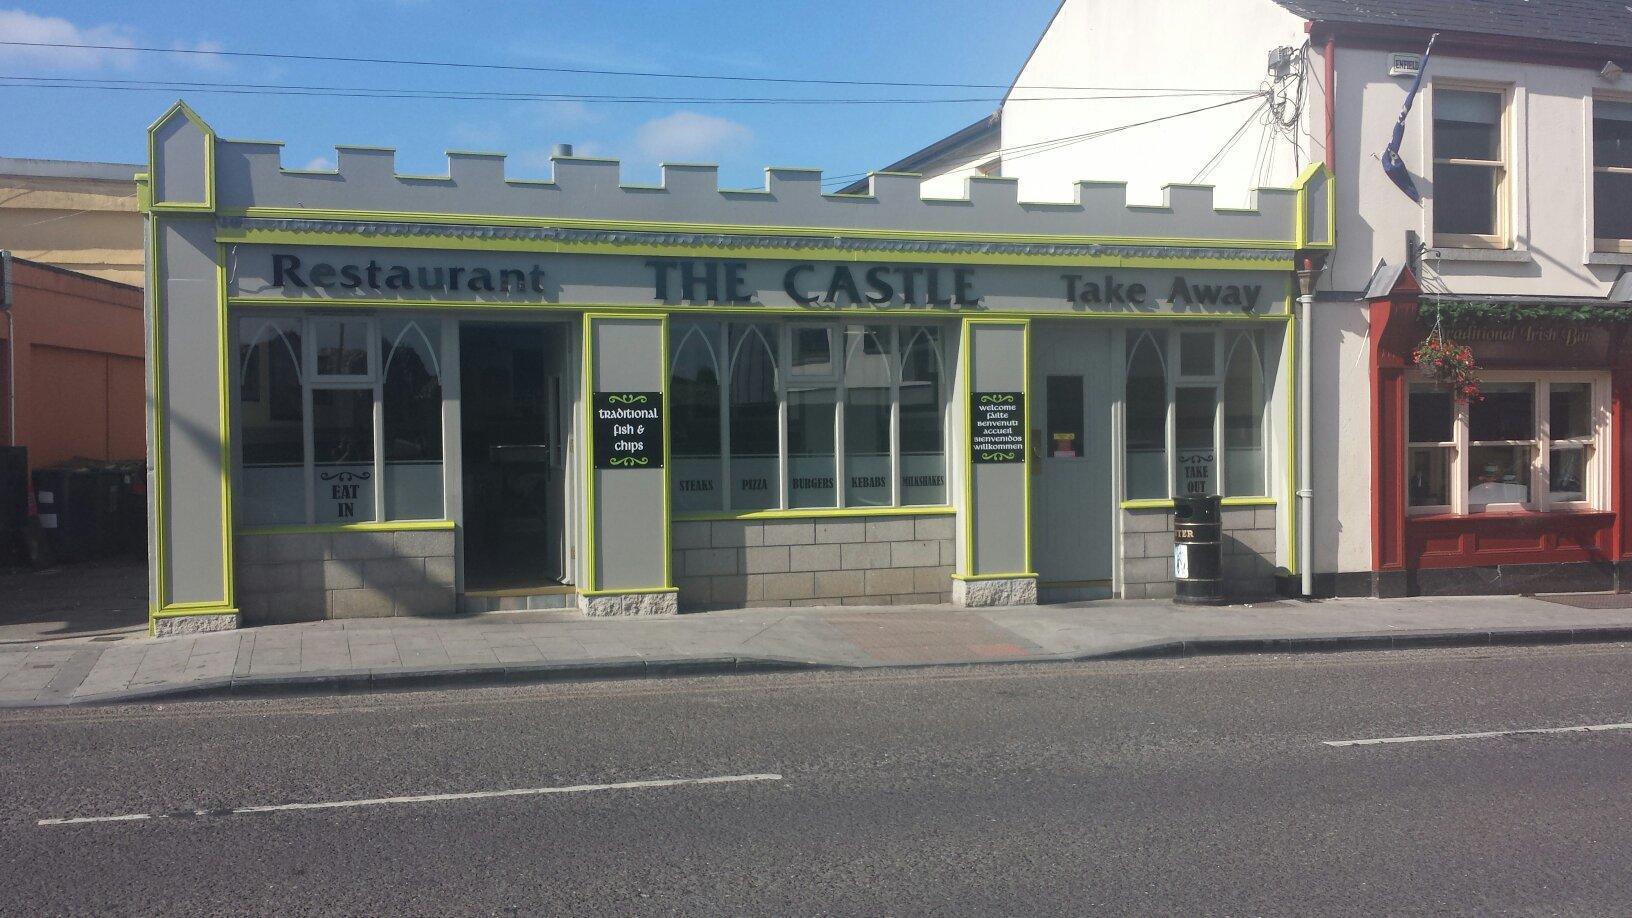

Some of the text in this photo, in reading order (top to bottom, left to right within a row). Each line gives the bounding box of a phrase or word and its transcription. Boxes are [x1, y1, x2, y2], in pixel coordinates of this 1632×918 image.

[271, 253, 546, 293] Restaurant
[646, 260, 981, 306] THE CASTLE
[1060, 274, 1262, 313] Take Away
[598, 407, 659, 419] traditional
[613, 424, 645, 437] fish &
[614, 440, 644, 453] chips
[1184, 465, 1209, 479] TAKE
[679, 479, 714, 492] STEAKS
[741, 478, 768, 490] PIZZA
[792, 477, 834, 490] BURGERS
[851, 476, 886, 488] KEBABS
[902, 475, 945, 487] MILKSHAKES
[1187, 481, 1206, 493] OUT
[332, 484, 360, 500] EAT
[338, 502, 355, 518] IN
